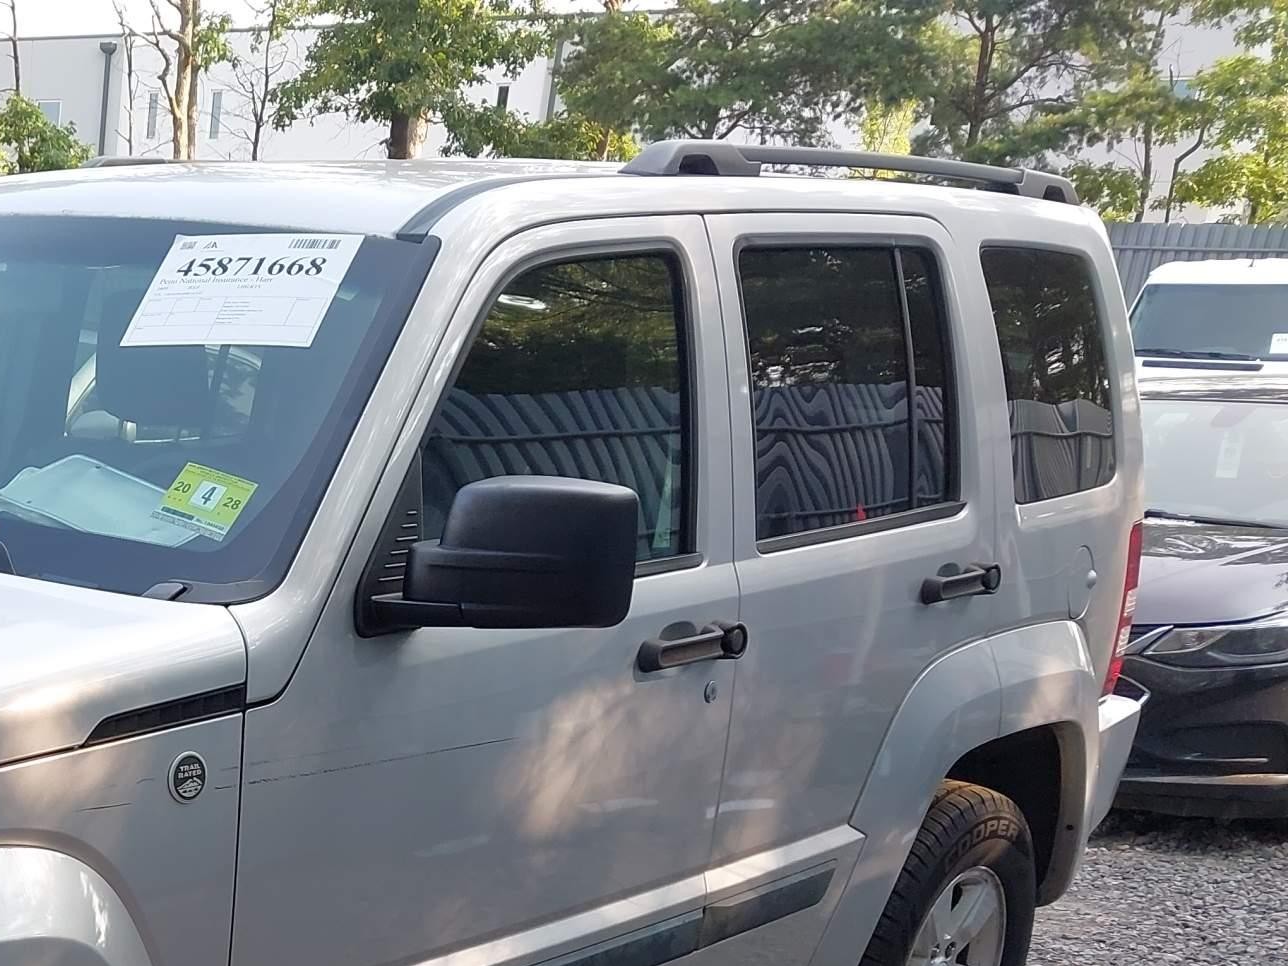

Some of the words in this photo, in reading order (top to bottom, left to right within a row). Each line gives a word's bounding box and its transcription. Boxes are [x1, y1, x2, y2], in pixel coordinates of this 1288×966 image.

[176, 256, 327, 277] 45871668
[179, 277, 211, 285] National
[211, 276, 248, 284] Insurance
[174, 481, 191, 494] 20
[201, 486, 217, 505] 4
[223, 497, 241, 510] 28
[179, 763, 201, 772] TRAIL
[178, 769, 202, 779] RATED
